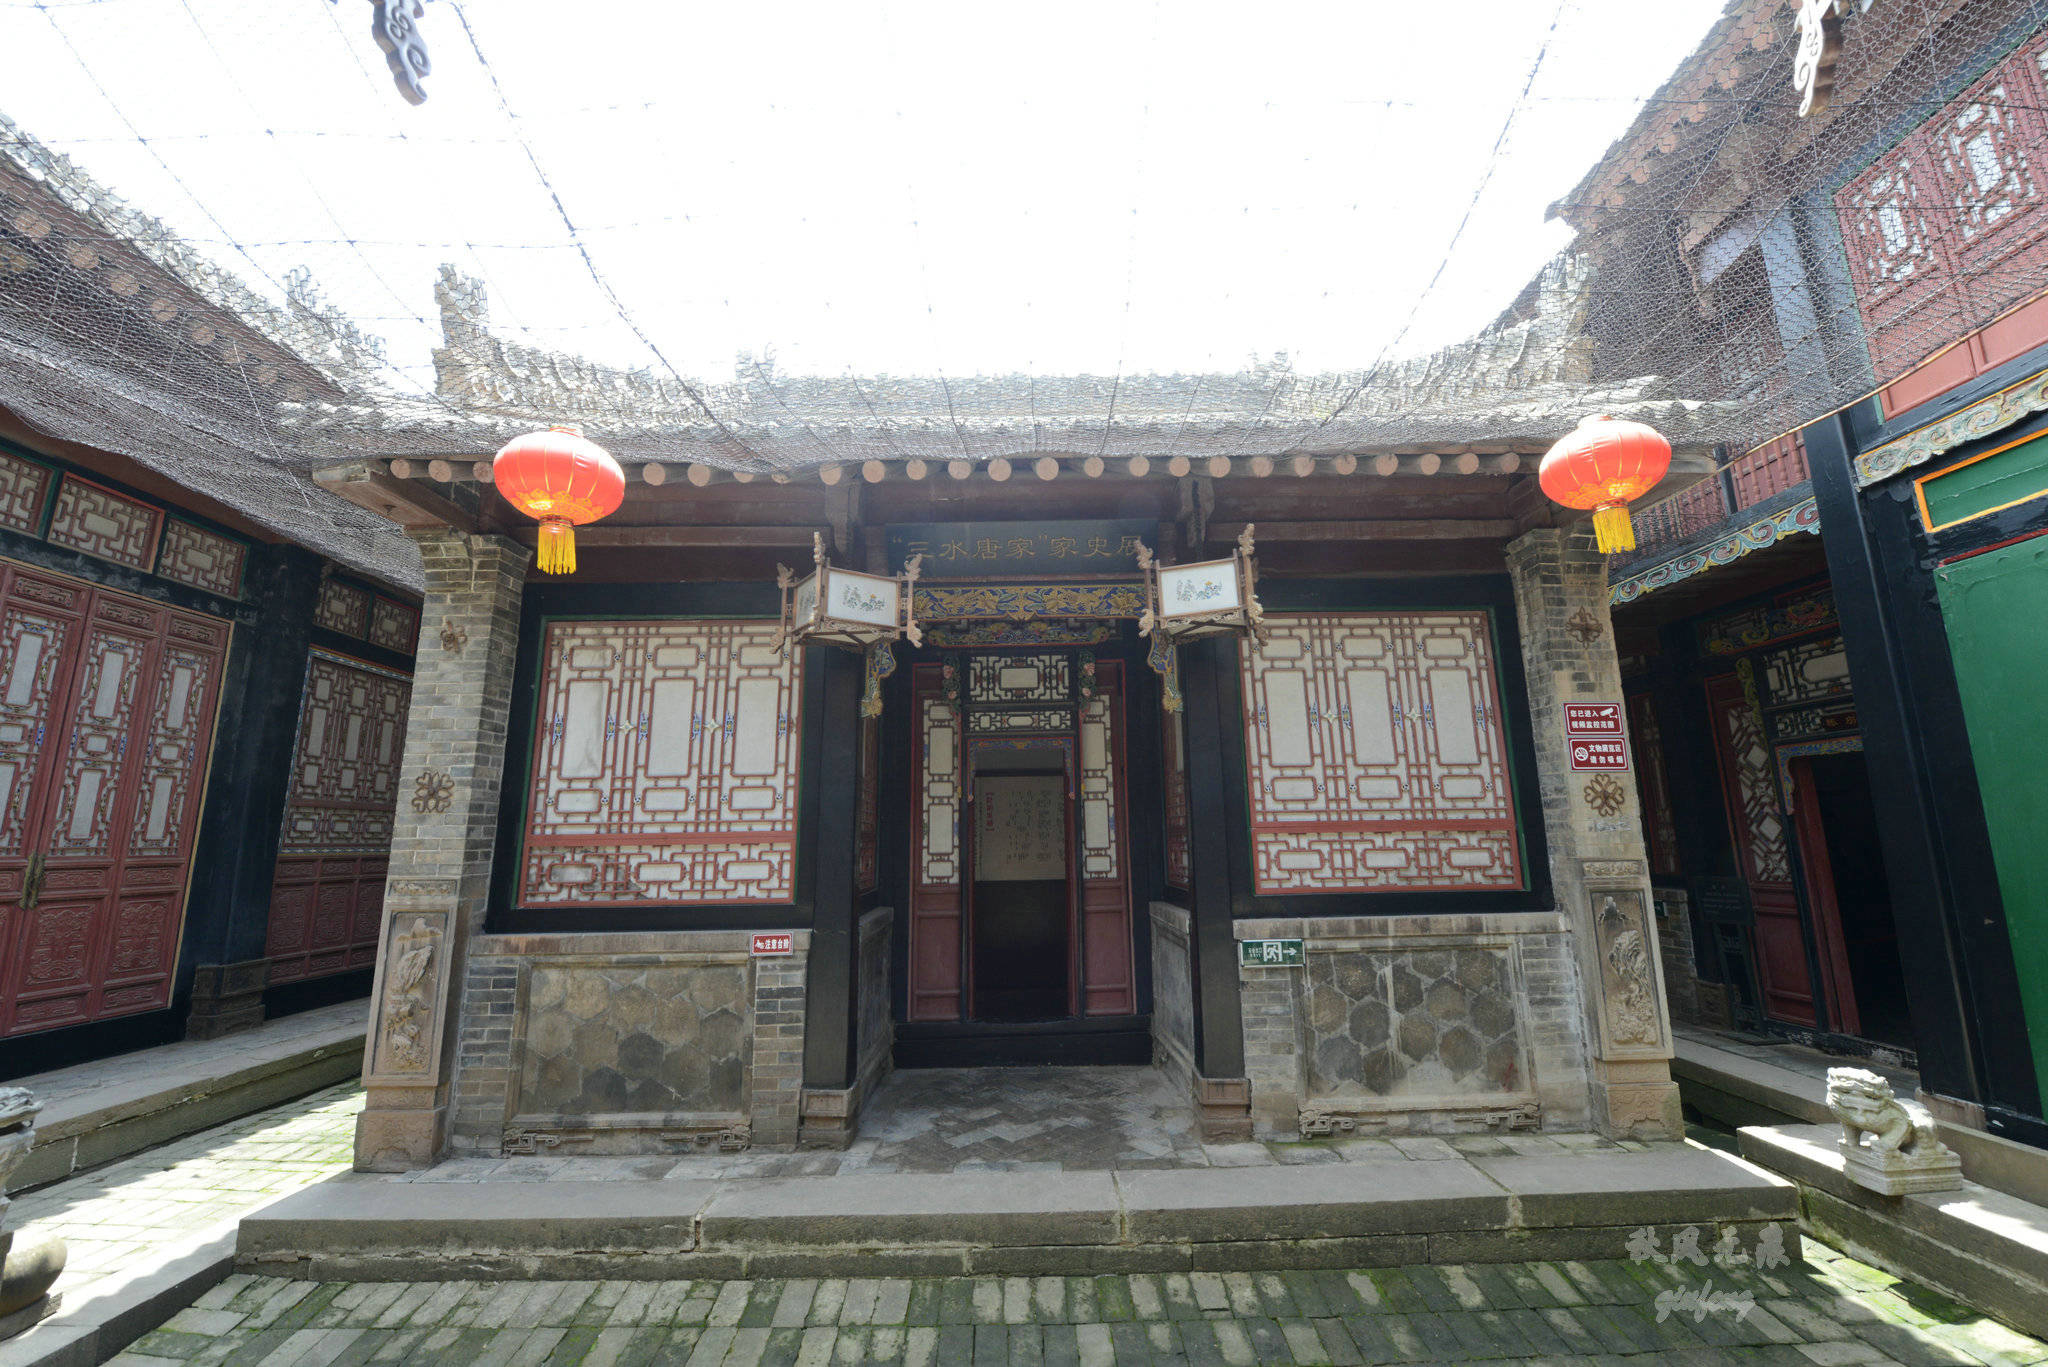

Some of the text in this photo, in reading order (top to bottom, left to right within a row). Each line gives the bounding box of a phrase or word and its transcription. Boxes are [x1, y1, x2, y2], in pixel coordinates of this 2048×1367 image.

[1569, 709, 1599, 718] 您已进入
[1571, 720, 1615, 729] 视频监控范围
[1589, 755, 1624, 764] 请勿吸烟
